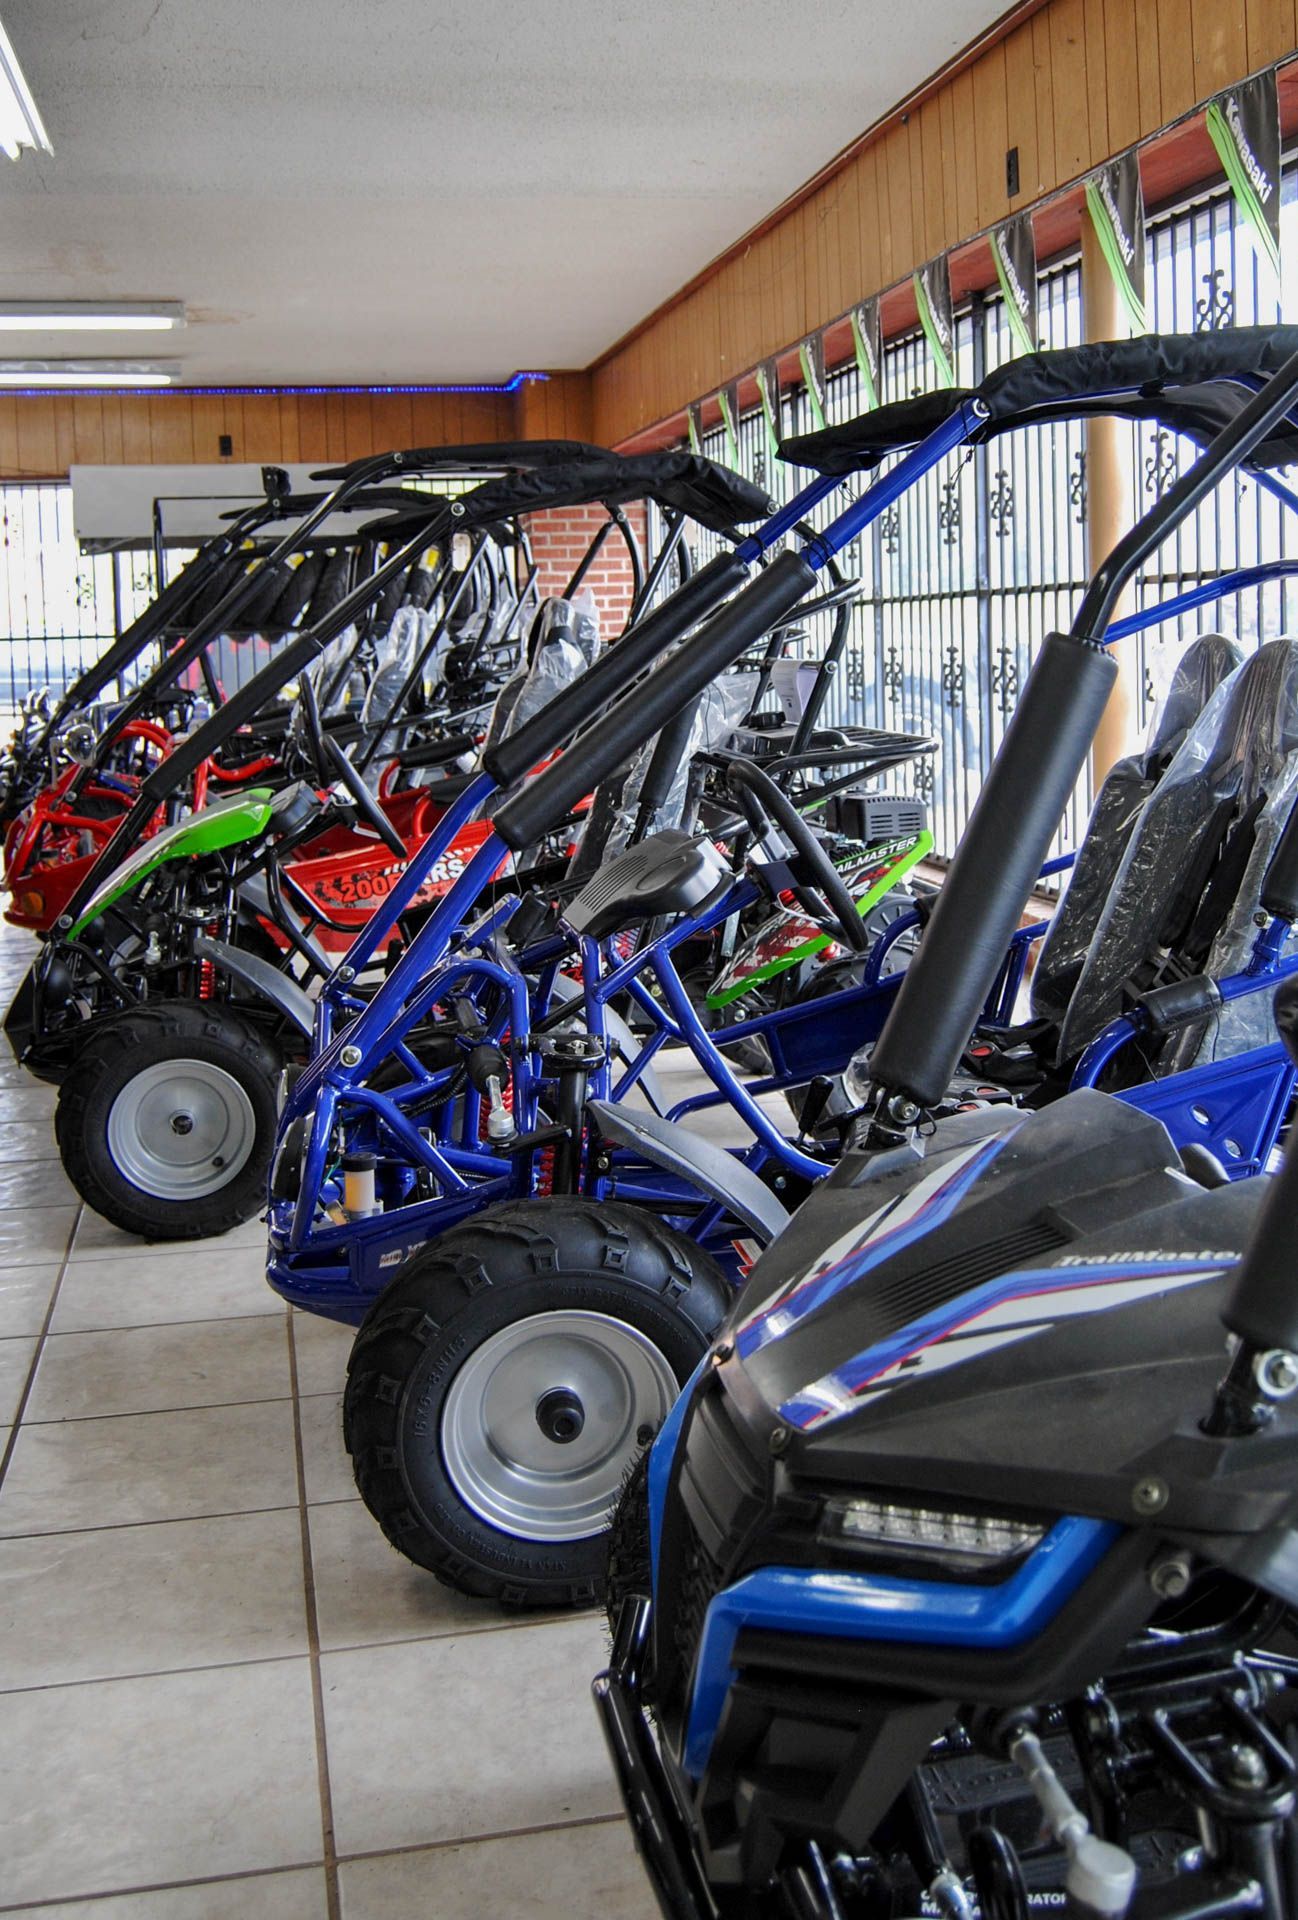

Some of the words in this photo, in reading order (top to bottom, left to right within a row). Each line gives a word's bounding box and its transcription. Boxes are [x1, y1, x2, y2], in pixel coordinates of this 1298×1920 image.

[1226, 97, 1272, 204] Kawasaki
[1100, 175, 1135, 266] Kawasaki
[423, 858, 465, 885] RS
[834, 836, 917, 873] AILMASTER
